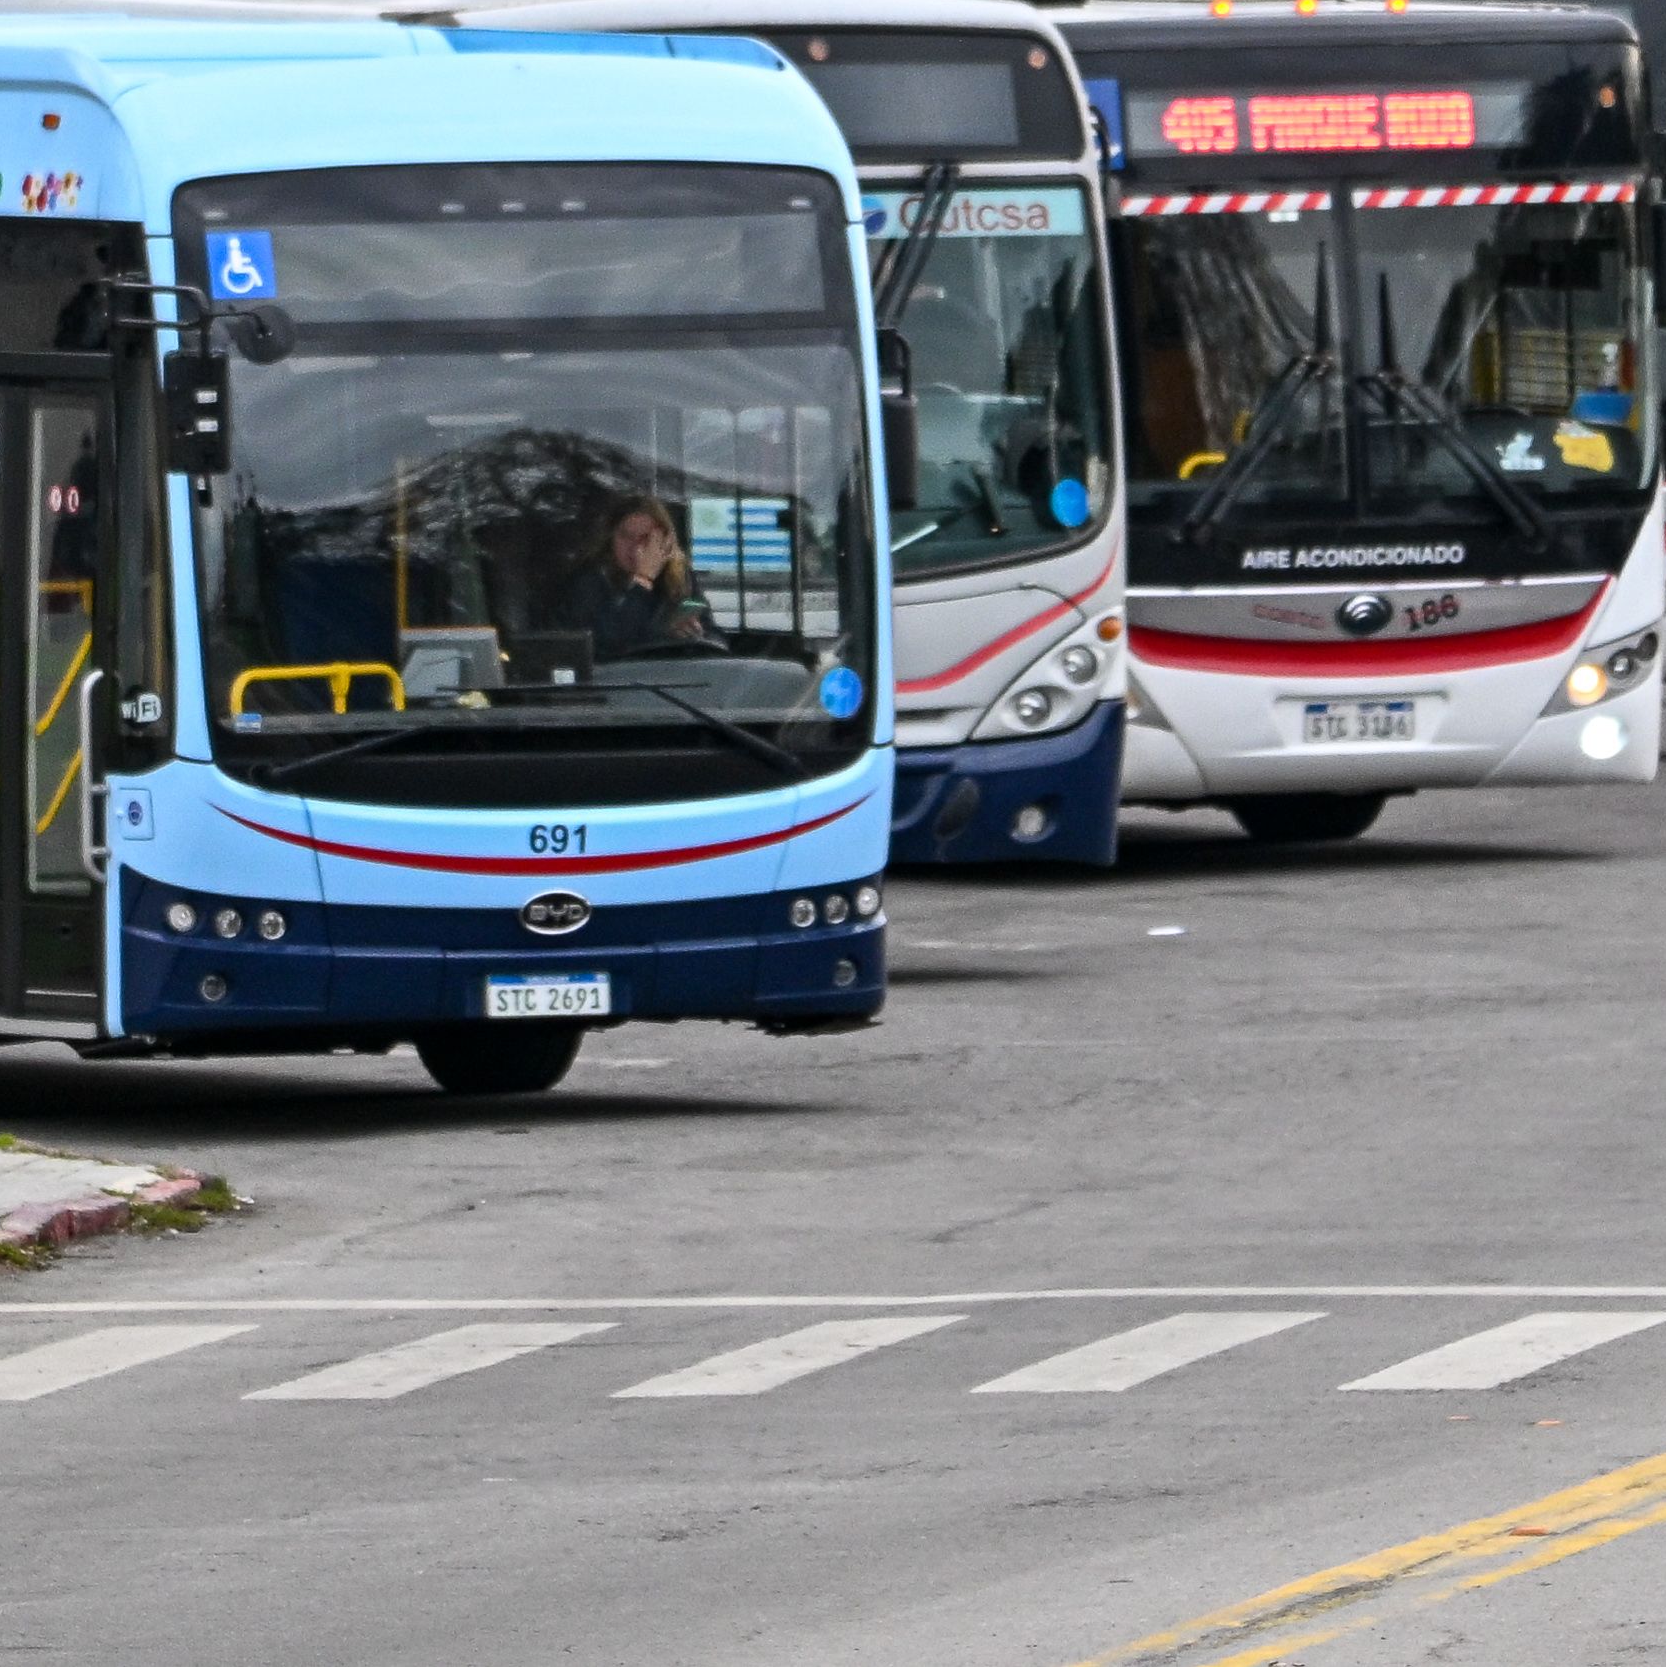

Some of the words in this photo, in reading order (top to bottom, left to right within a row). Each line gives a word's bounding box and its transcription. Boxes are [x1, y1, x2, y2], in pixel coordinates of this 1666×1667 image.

[1241, 549, 1291, 569] AIRE
[1295, 543, 1466, 568] ACONDICIONADO
[529, 824, 587, 854] 691
[530, 904, 582, 920] BYD
[497, 988, 536, 1012] STC
[549, 987, 600, 1013] 2691
